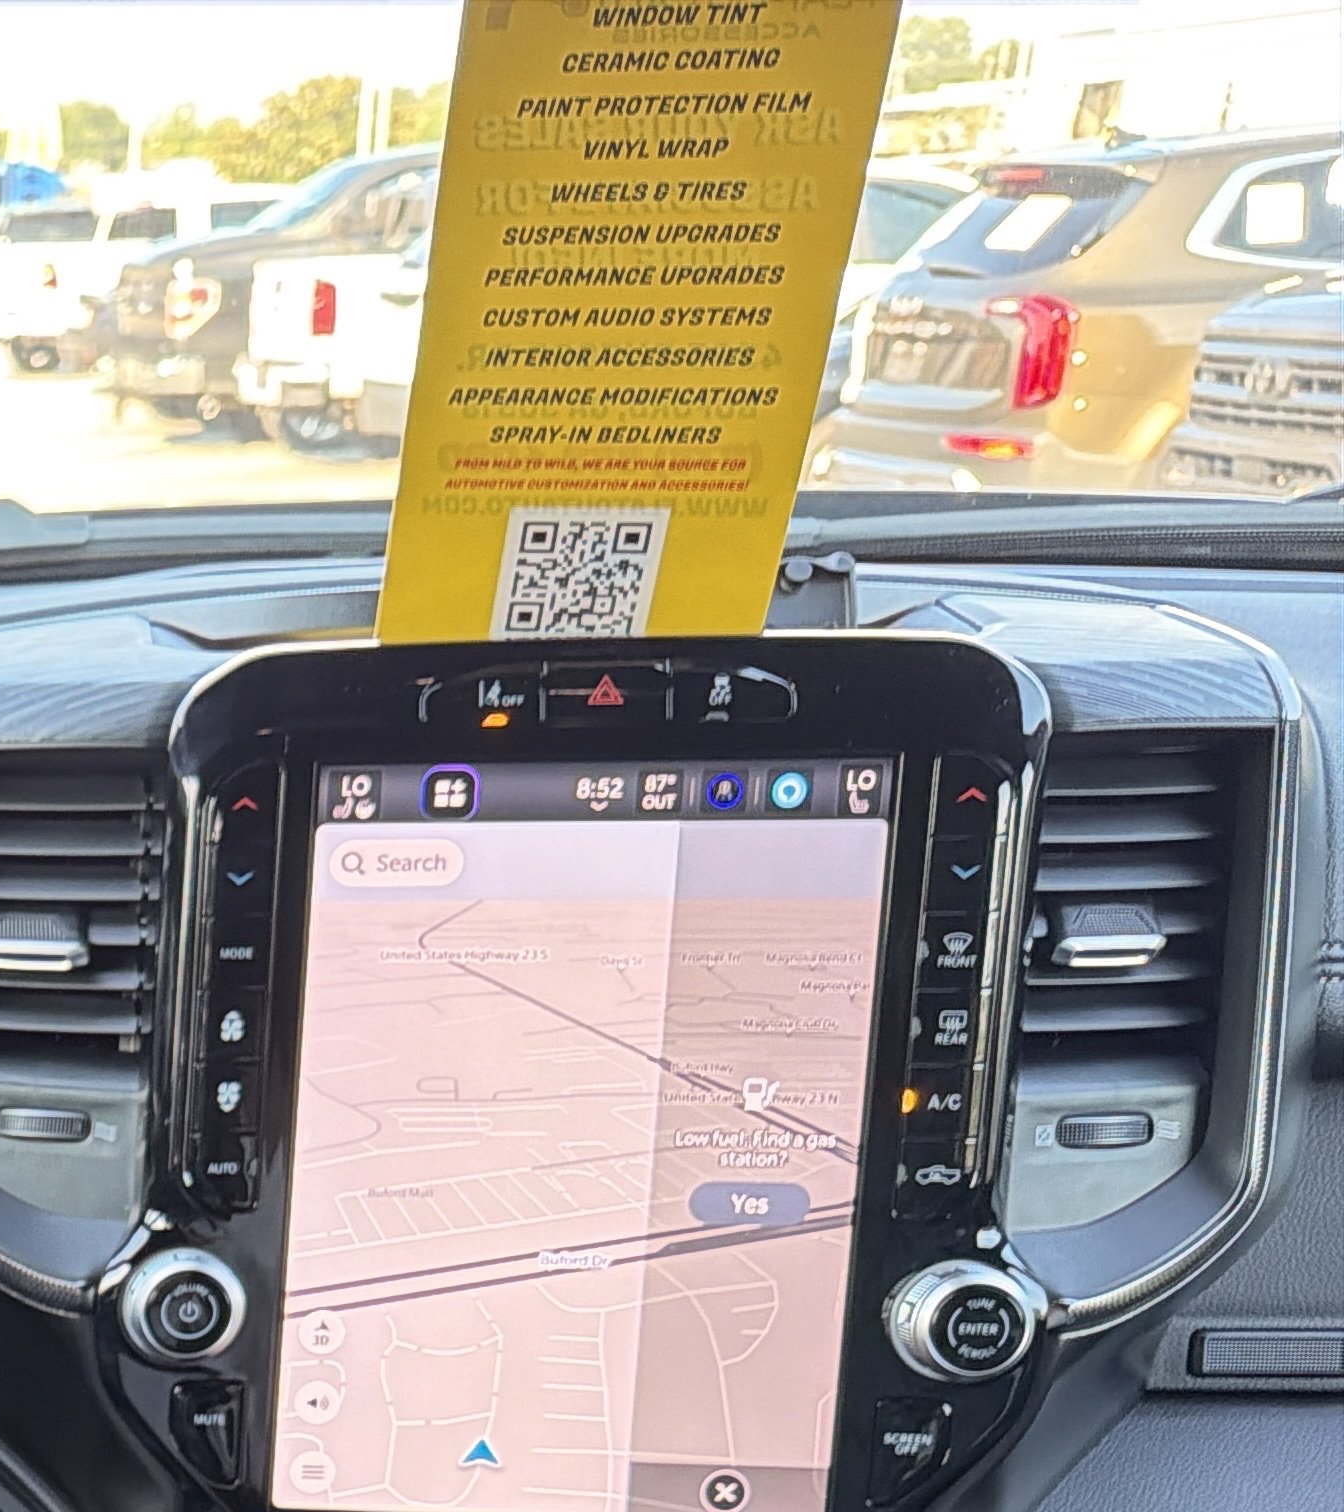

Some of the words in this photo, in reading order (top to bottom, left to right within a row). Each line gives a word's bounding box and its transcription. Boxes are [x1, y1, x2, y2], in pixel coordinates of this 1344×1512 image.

[592, 5, 695, 28] WINDOW
[706, 2, 768, 25] TINT
[562, 50, 670, 73] CERAMIC
[674, 47, 782, 70] COATING
[516, 97, 592, 119] PAINT
[593, 92, 749, 117] PROTECTION
[752, 90, 813, 113] FILM
[582, 138, 650, 161] VINYL
[656, 136, 730, 159] WRAP
[550, 180, 648, 204] WHEELS
[653, 181, 671, 202] &
[677, 179, 749, 202] TIRES
[502, 223, 651, 246] SUSPENSION
[655, 222, 782, 243] UPGRADES
[484, 264, 657, 288] PERFORMANCE
[660, 264, 786, 286] UPGRADES
[482, 306, 579, 329] CUSTOM
[583, 306, 656, 328] AUDIO
[660, 305, 773, 327] SYSTEMS
[483, 347, 593, 368] INTERIOR
[594, 345, 756, 367] ACCESSORIES
[448, 386, 596, 408] APPEARANCE
[599, 386, 779, 406] MODIFICATIONS
[489, 425, 593, 445] SPRAY-IN
[597, 425, 722, 445] BEDLINERS
[455, 457, 490, 470] FROM
[492, 458, 522, 470] MILD
[526, 458, 542, 470] TO
[583, 458, 602, 470] WE
[605, 458, 629, 470] ARE
[633, 458, 666, 470] YOUR
[668, 458, 719, 470] SOURCE
[720, 458, 747, 471] FOR
[445, 478, 526, 490] AUTOMOTIVE
[527, 478, 628, 491] CUSTOMIZATION
[631, 479, 656, 491] AND
[658, 479, 750, 492] ACCESSORIES!
[341, 774, 372, 797] LO
[575, 777, 625, 801] 8:52
[846, 770, 877, 792] LO
[642, 794, 677, 812] OUT
[376, 853, 447, 874] Search
[219, 945, 255, 962] MODE
[380, 950, 421, 960] United
[424, 949, 462, 960] States
[464, 950, 520, 962] Highway
[937, 953, 977, 970] FRONT
[934, 1028, 969, 1046] REAR
[927, 1093, 962, 1112] A/C
[675, 1130, 710, 1149] Low
[712, 1129, 750, 1149] fuel.
[752, 1128, 790, 1148] Find
[792, 1134, 803, 1148] a
[806, 1133, 837, 1151] gas
[206, 1161, 238, 1176] AUTO
[719, 1151, 789, 1168] station?
[730, 1193, 769, 1215] Yes
[958, 1322, 999, 1336] ENTER
[193, 1412, 226, 1427] MUTE
[883, 1431, 933, 1447] SCREEN
[894, 1443, 920, 1457] OFF
